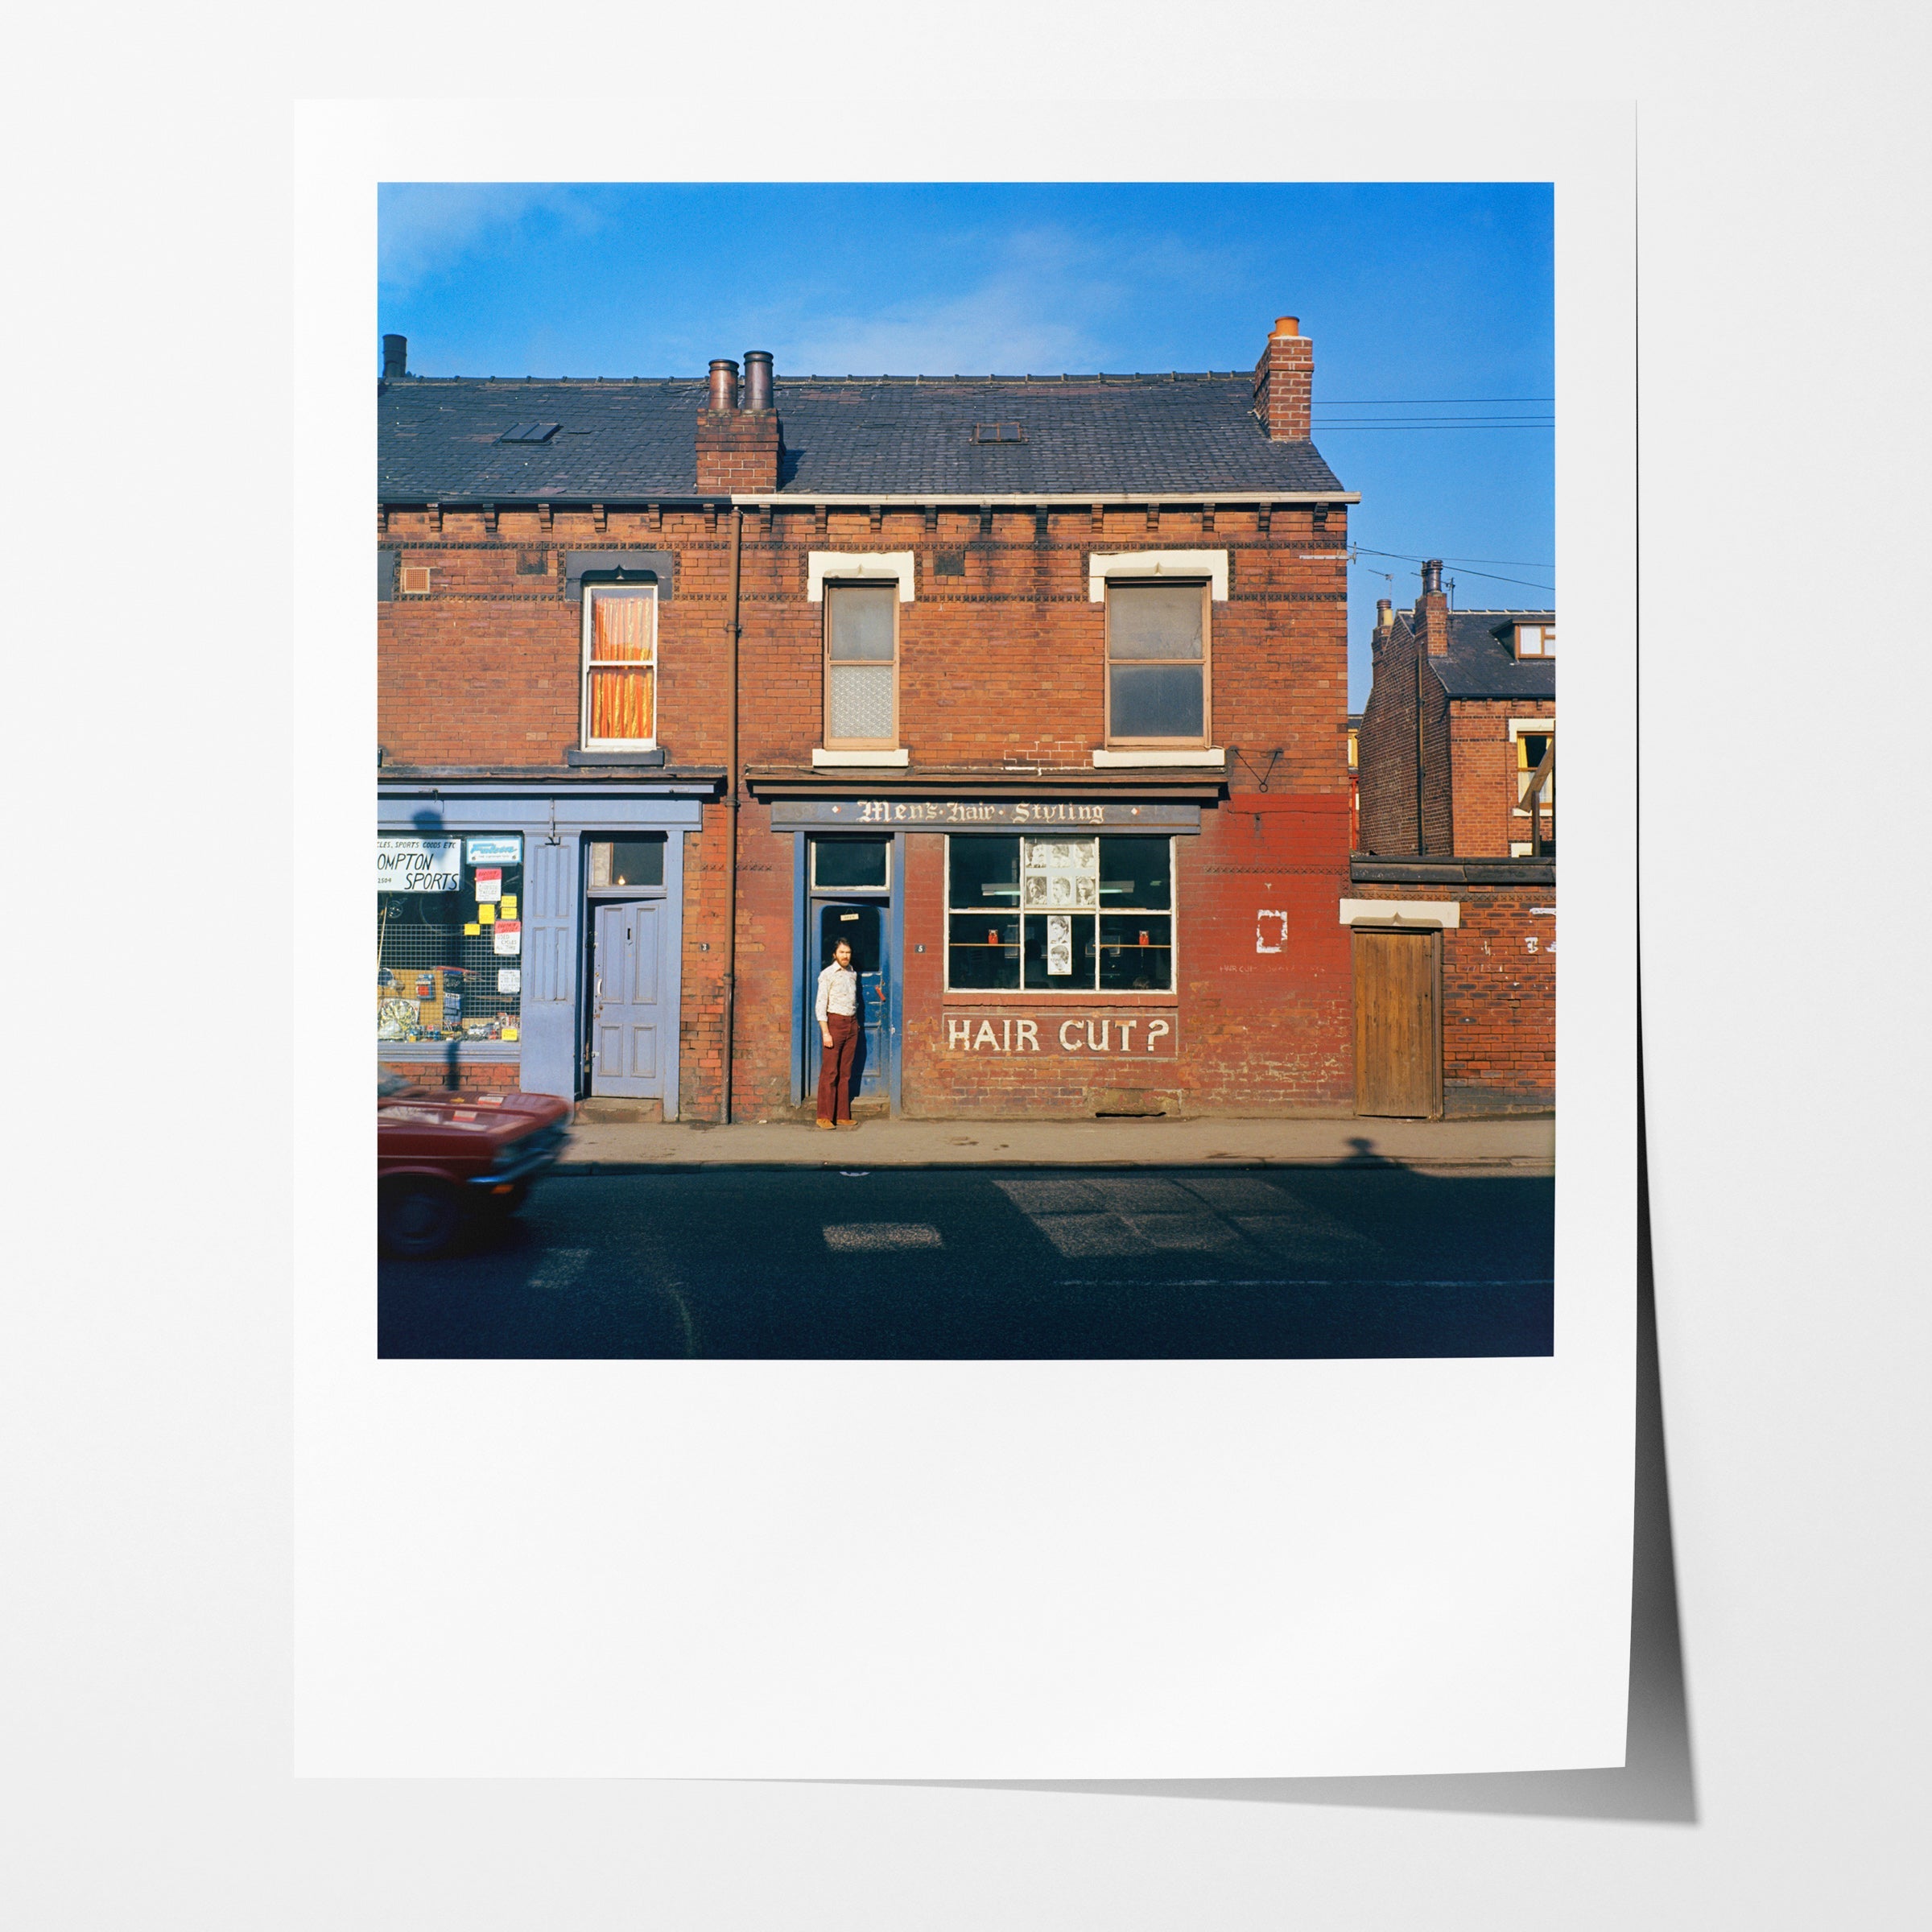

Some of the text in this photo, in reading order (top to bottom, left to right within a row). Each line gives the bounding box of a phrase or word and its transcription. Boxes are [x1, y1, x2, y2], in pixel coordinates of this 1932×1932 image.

[857, 801, 939, 822] Men's
[1012, 802, 1104, 824] Styling
[378, 853, 434, 870] OMPTON
[404, 873, 459, 890] SPORTS
[947, 1019, 1041, 1051] HAIR
